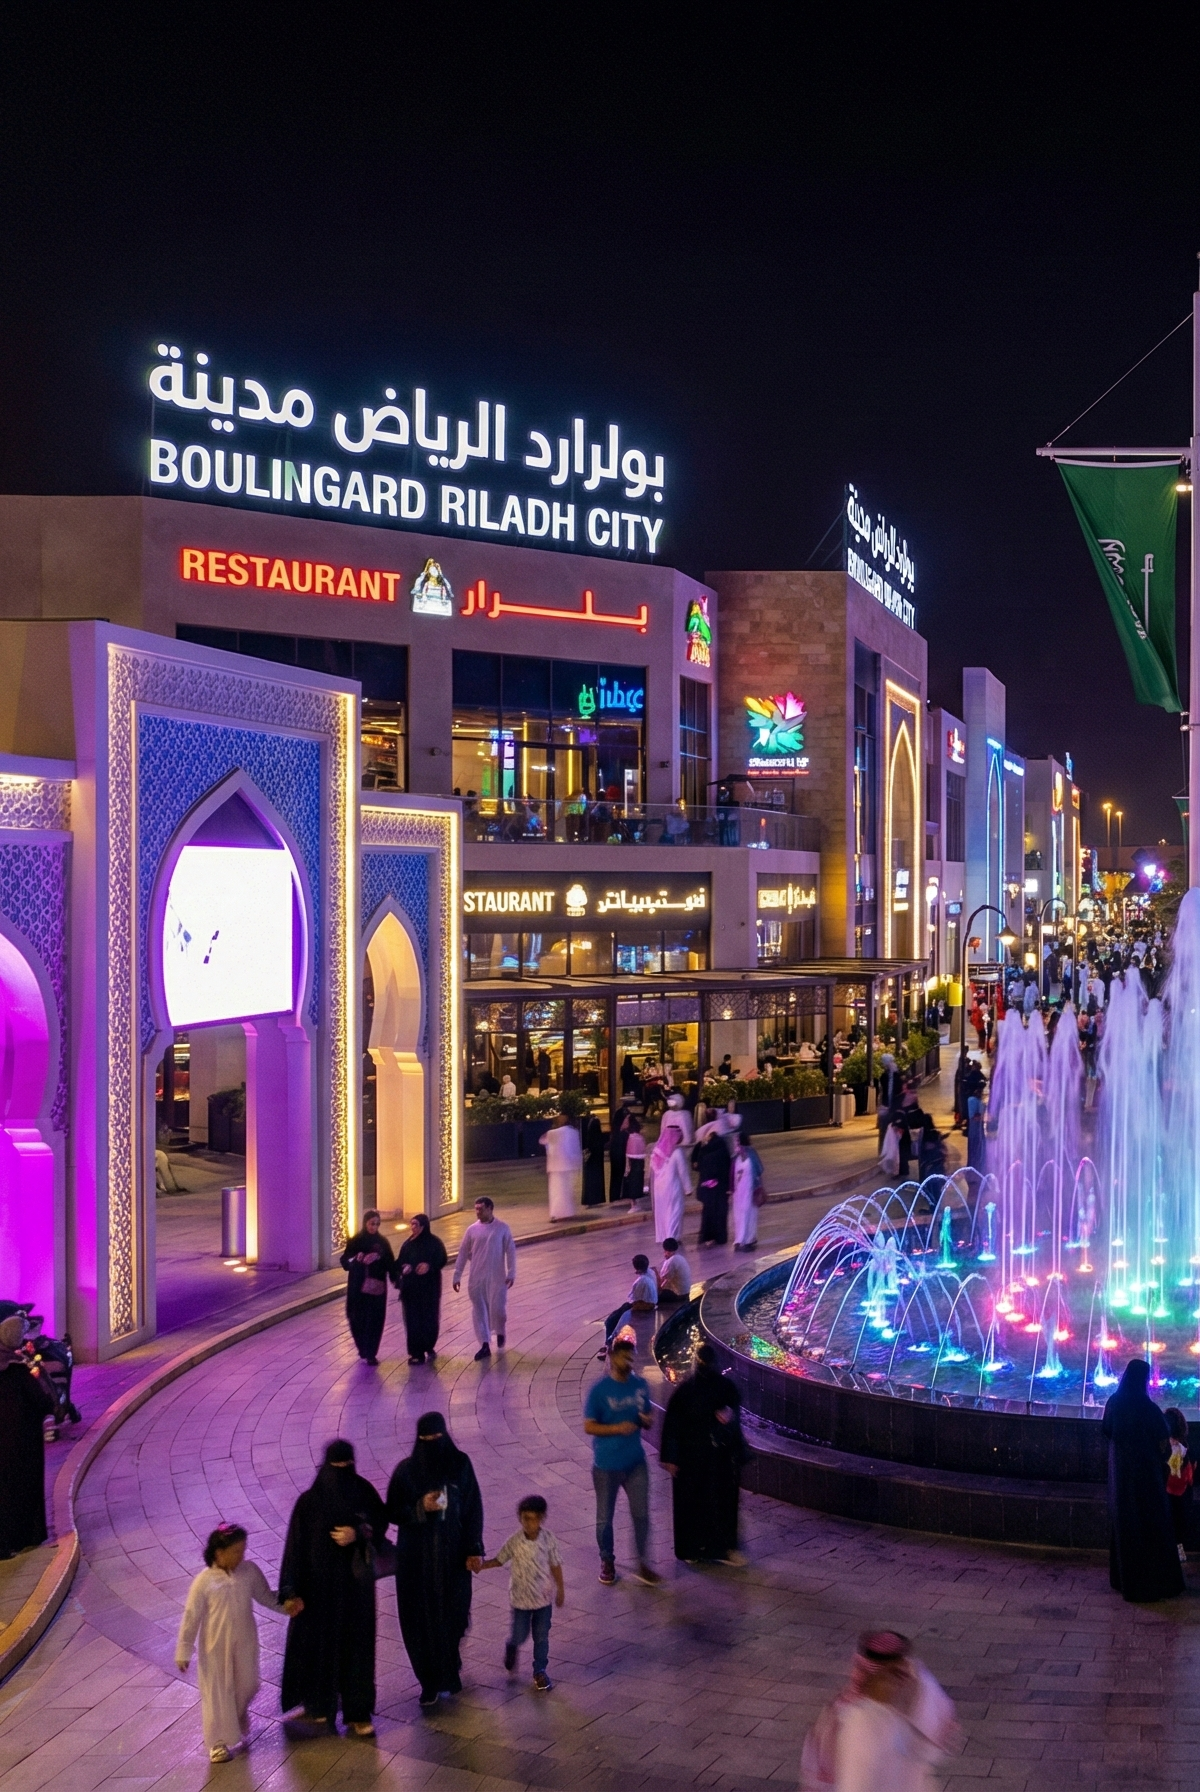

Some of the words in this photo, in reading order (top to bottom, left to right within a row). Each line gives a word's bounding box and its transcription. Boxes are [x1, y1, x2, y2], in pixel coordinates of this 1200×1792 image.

[149, 343, 314, 433] مدينة
[334, 387, 506, 470] الرياض
[150, 438, 426, 520] BOULINGARD
[440, 484, 576, 542] RILADH
[587, 508, 663, 554] CITY
[182, 548, 400, 602] RESTAURANT
[463, 891, 555, 912] STAURANT
